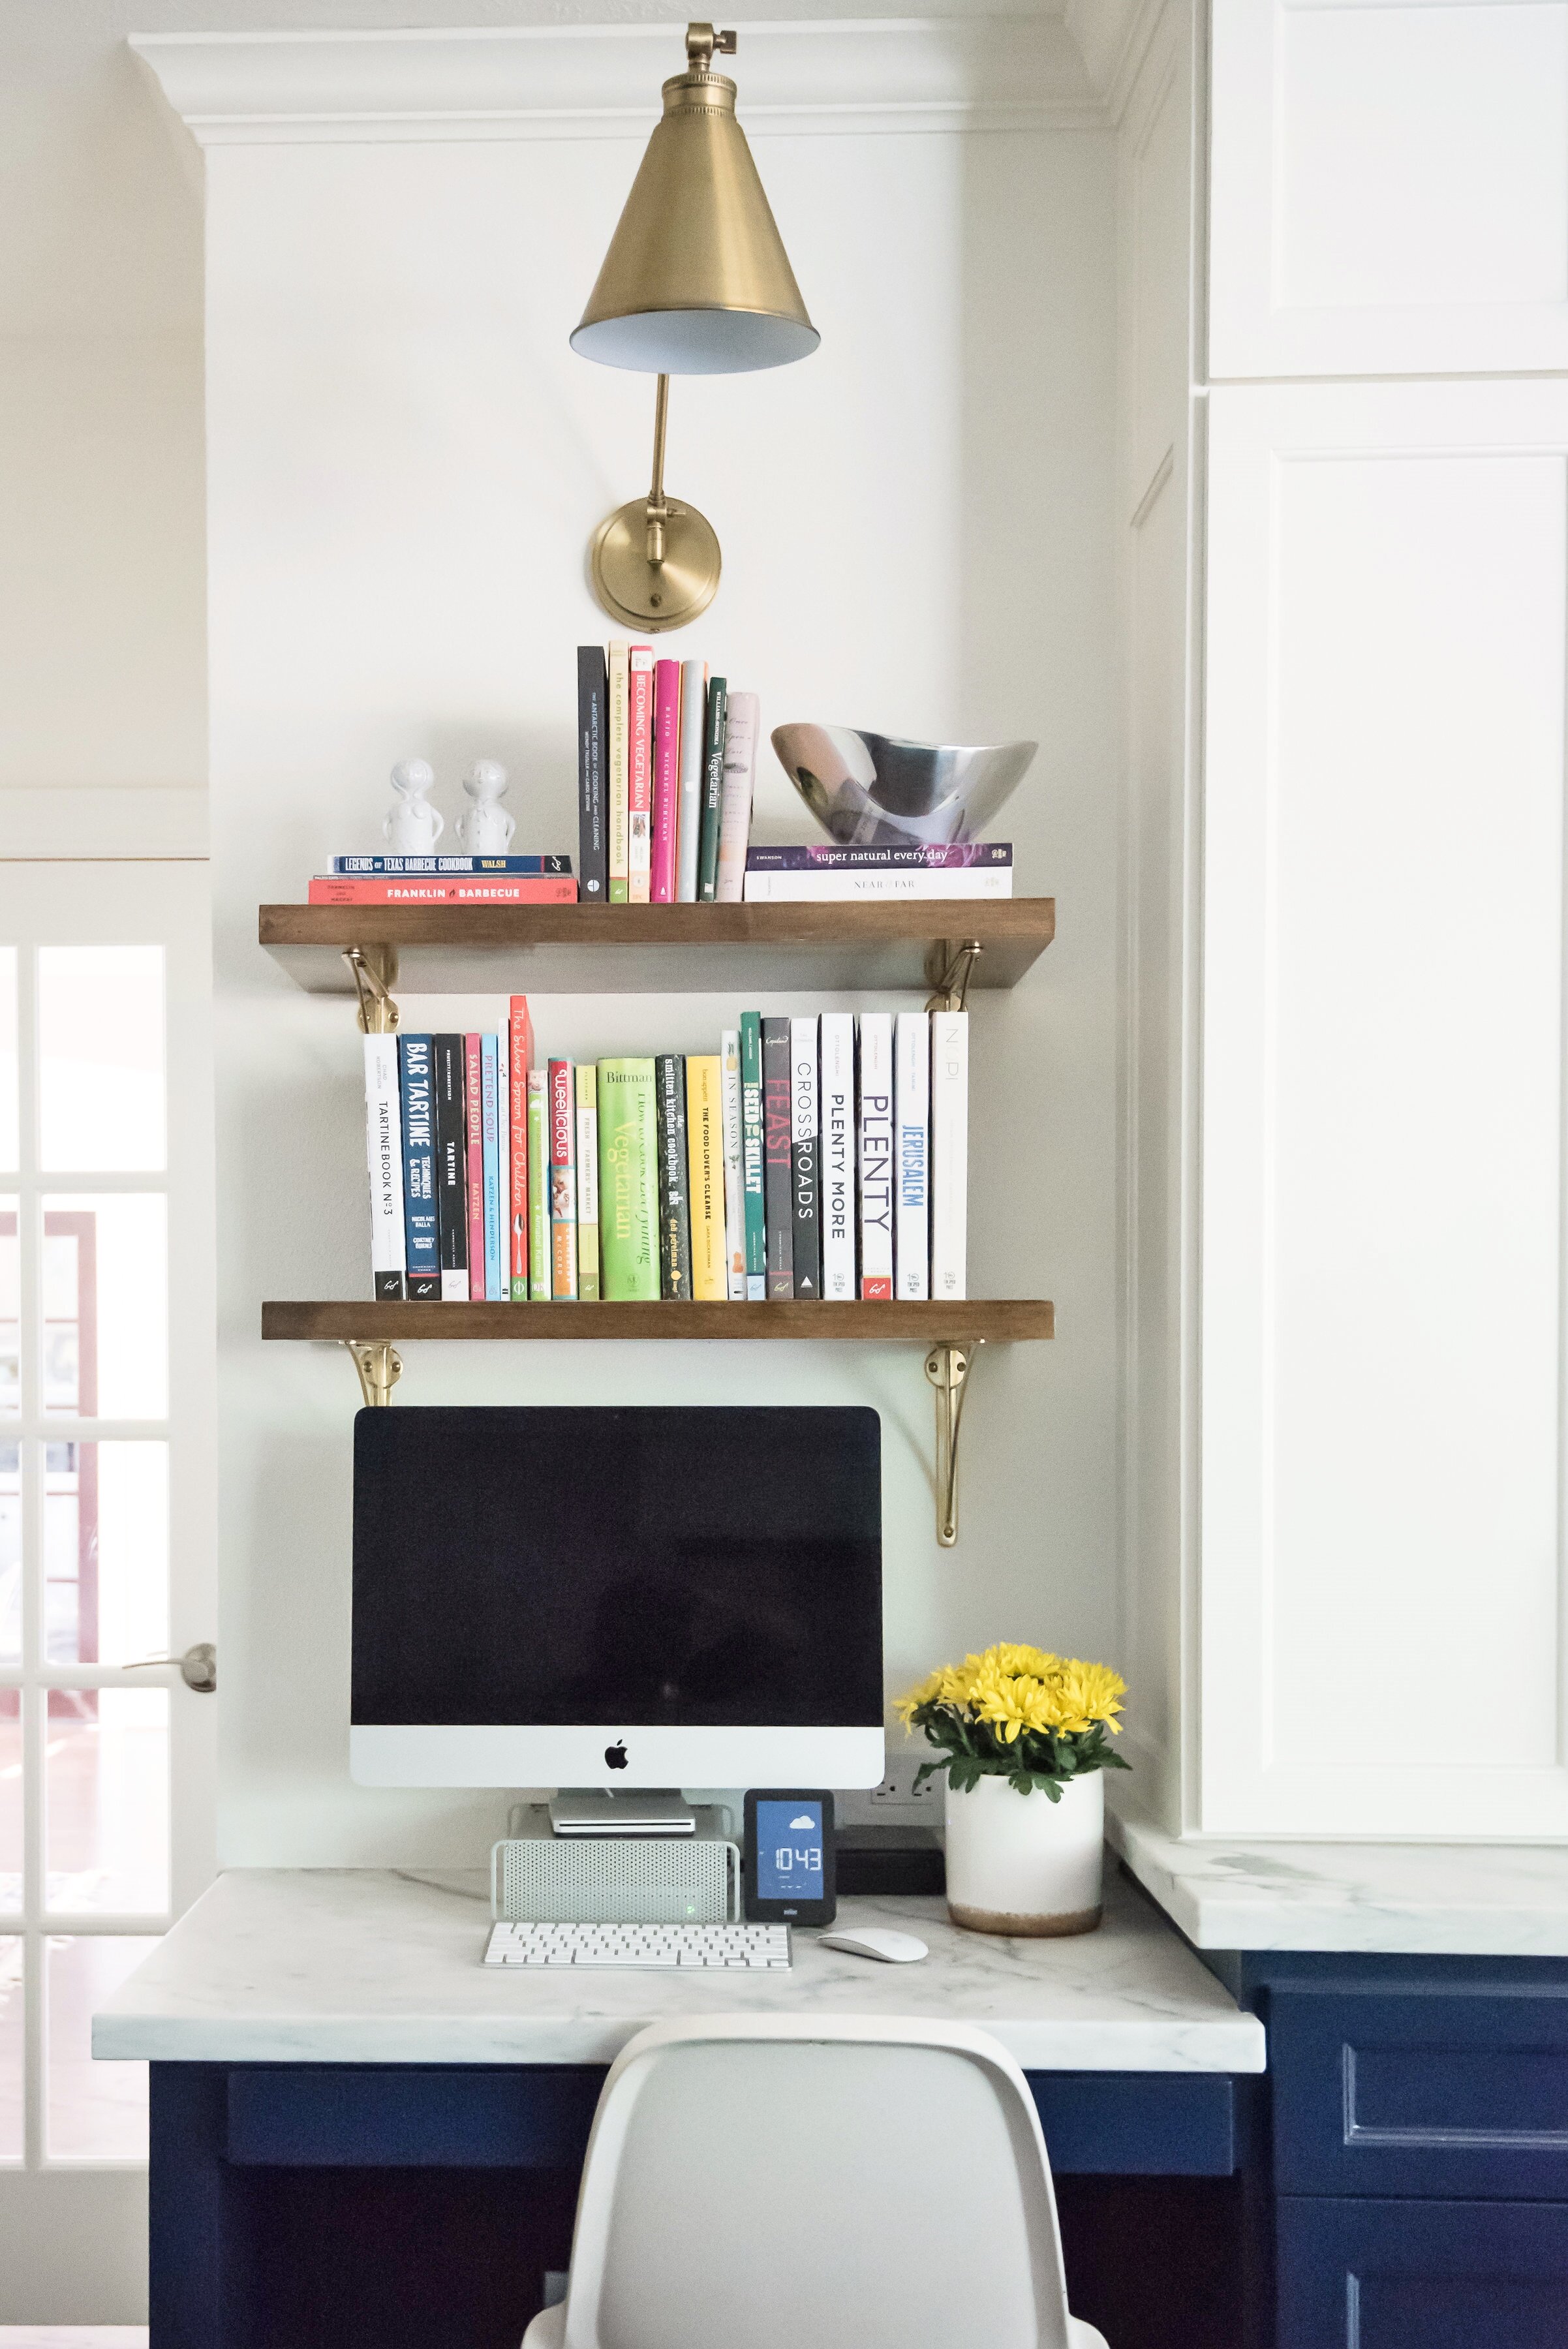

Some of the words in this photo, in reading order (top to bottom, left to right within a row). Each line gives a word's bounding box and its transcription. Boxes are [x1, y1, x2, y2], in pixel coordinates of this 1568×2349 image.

[614, 694, 623, 742] complete
[635, 674, 646, 736] BECOMING
[614, 748, 623, 805] vegetarian
[634, 739, 645, 809] VEGETARIAN
[709, 752, 722, 808] Vegetarian
[615, 811, 624, 864] handbook
[816, 853, 847, 865] super
[850, 850, 891, 861] natural
[894, 851, 925, 863] every
[928, 849, 947, 863] day
[345, 857, 373, 871] LEGENDS
[384, 857, 403, 871] TEXAS
[405, 857, 437, 871] BARBECUE
[438, 857, 473, 871] COOKBOOK
[481, 859, 506, 868] WALSH
[895, 880, 915, 888] FAR
[387, 889, 446, 898] FRANKLIN
[459, 888, 520, 898] BARBECUE
[514, 1007, 525, 1029] The
[406, 1043, 428, 1075] BAR
[469, 1053, 478, 1095] SALAD
[514, 1035, 525, 1075] Silver
[945, 1028, 959, 1081] NOPI
[485, 1054, 493, 1110] PRETEND
[607, 1071, 652, 1083] Bittman
[665, 1058, 676, 1096] smitten
[728, 1076, 737, 1091] IN
[407, 1080, 431, 1147] TARTINE
[469, 1099, 480, 1145] PEOPLE
[512, 1081, 525, 1120] Spoon
[555, 1069, 572, 1158] weelicious
[666, 1098, 677, 1135] kitchen
[745, 1088, 760, 1123] SEED
[378, 1101, 390, 1151] TARTINE
[485, 1112, 495, 1143] SOUP
[512, 1126, 525, 1147] for
[729, 1098, 739, 1148] SEASON
[765, 1079, 792, 1169] FEAST
[797, 1062, 814, 1220] CROSSROADS
[831, 1094, 844, 1173] PLENTY
[381, 1154, 392, 1188] BOOK
[409, 1158, 420, 1167] &
[421, 1156, 432, 1199] TECHNIQUES
[447, 1141, 455, 1186] TARTINE
[514, 1152, 526, 1207] Children
[607, 1120, 636, 1240] Vegetarian
[667, 1138, 679, 1182] cookbook
[745, 1138, 761, 1194] SKILLET
[863, 1096, 889, 1232] PLENTY
[902, 1124, 924, 1206] JERUSALEM
[410, 1168, 421, 1197] RECIPES
[472, 1182, 480, 1220] KATZEN
[669, 1218, 678, 1232] deb
[832, 1182, 845, 1238] MORE
